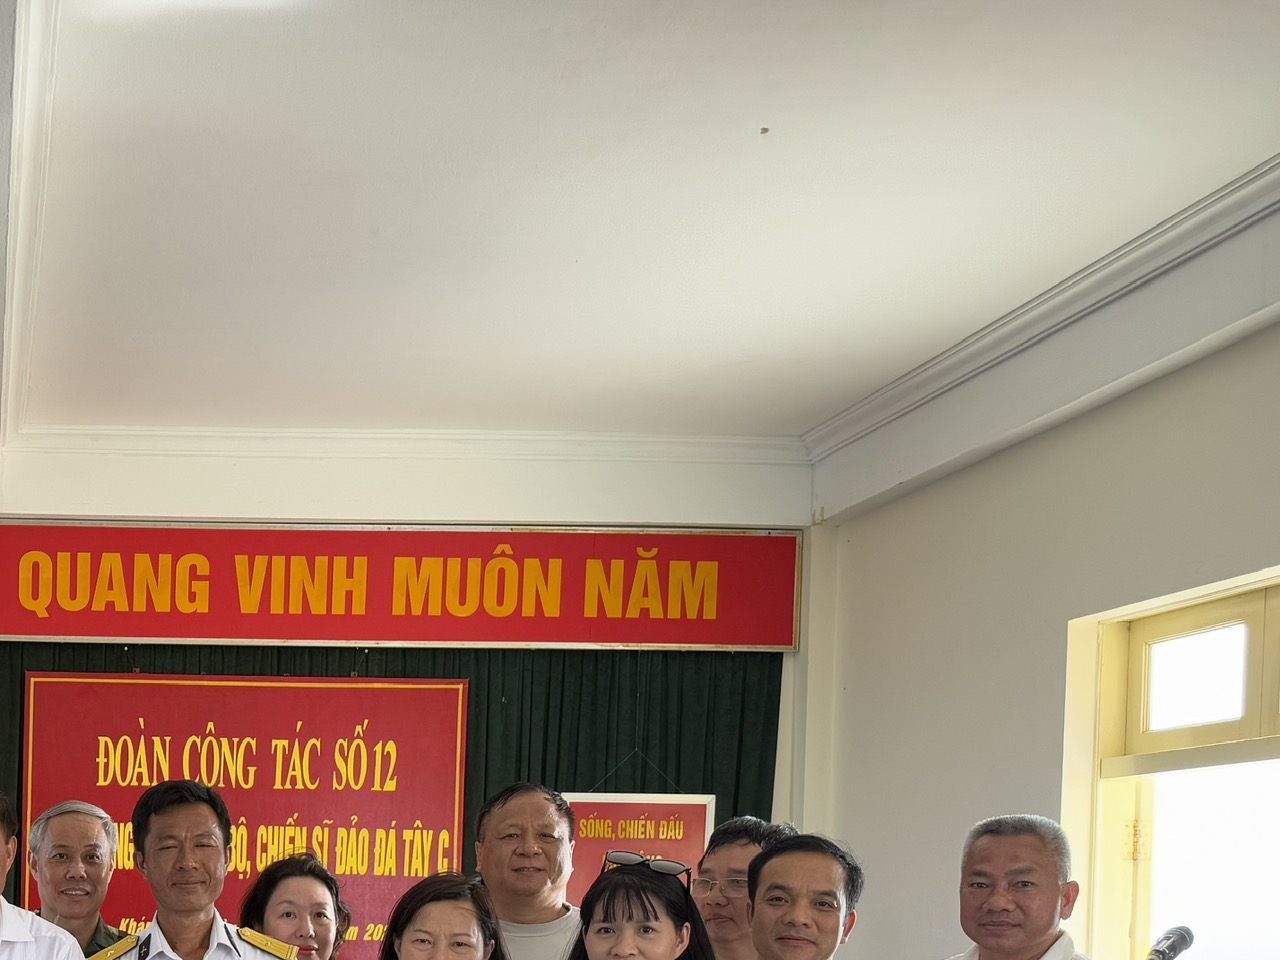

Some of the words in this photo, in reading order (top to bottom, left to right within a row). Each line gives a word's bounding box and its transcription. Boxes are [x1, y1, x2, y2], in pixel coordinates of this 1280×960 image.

[18, 549, 211, 618] QUANG
[234, 553, 368, 616] VINH
[392, 544, 562, 618] MUÔN
[584, 546, 719, 621] NĂM
[96, 717, 173, 787] ĐOÀN
[182, 721, 257, 789] CÔNG
[271, 720, 321, 790] TÁC
[114, 821, 134, 870] NG
[256, 812, 308, 872] CHIẾN
[311, 819, 334, 870] SĨ
[335, 815, 370, 876] ĐẢO
[373, 820, 398, 877] ĐÁ
[402, 820, 434, 878] TÂY
[437, 828, 451, 876] C
[578, 811, 616, 842] SỐNG,
[617, 812, 655, 840] CHIẾN
[658, 812, 685, 841] ĐẤU
[363, 923, 388, 941] 20
